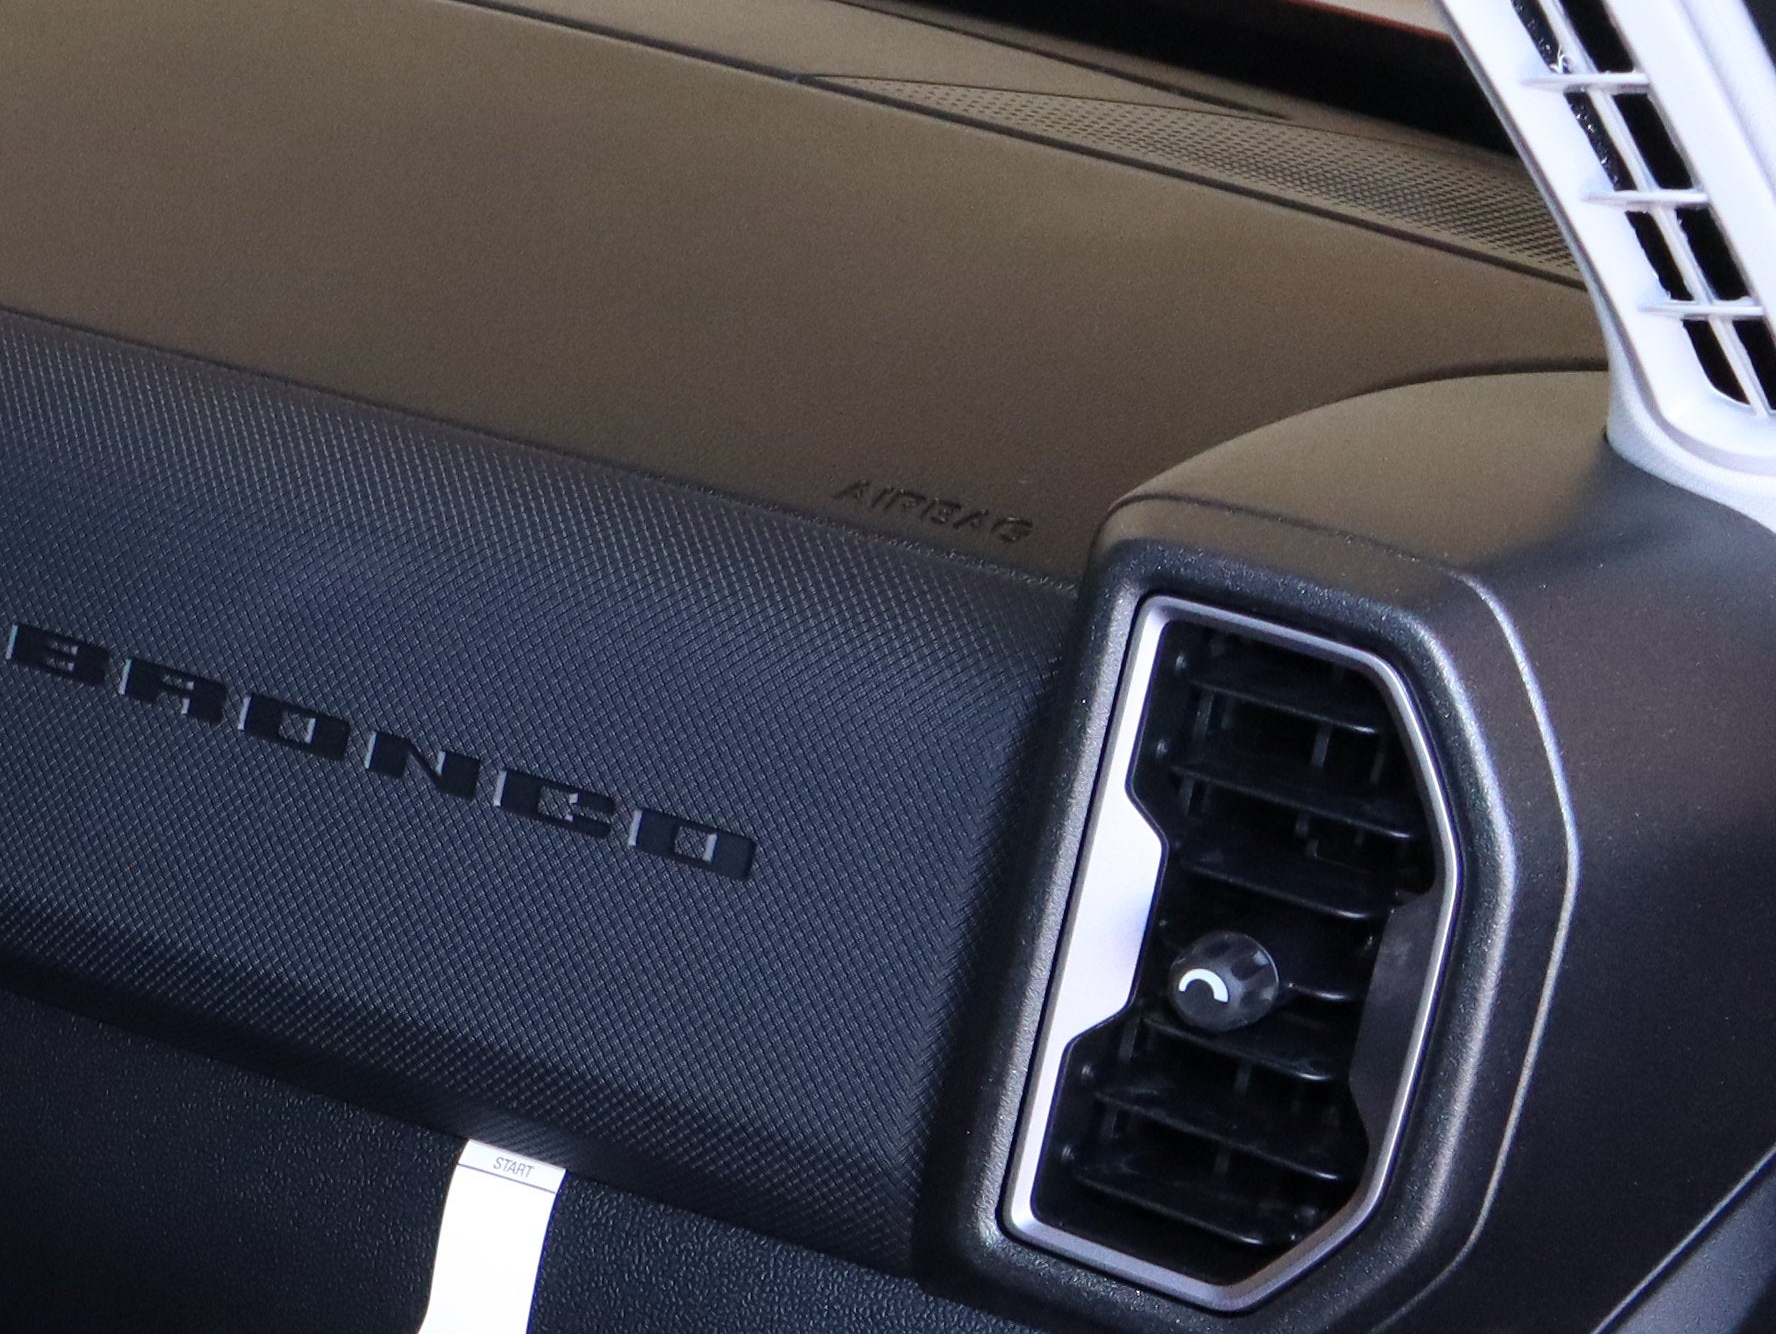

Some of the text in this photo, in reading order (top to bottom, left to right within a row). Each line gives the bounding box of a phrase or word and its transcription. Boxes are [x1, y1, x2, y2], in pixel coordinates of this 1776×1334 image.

[832, 478, 1034, 544] AIRBAG
[5, 623, 758, 883] BRONCO
[493, 1156, 536, 1179] START
